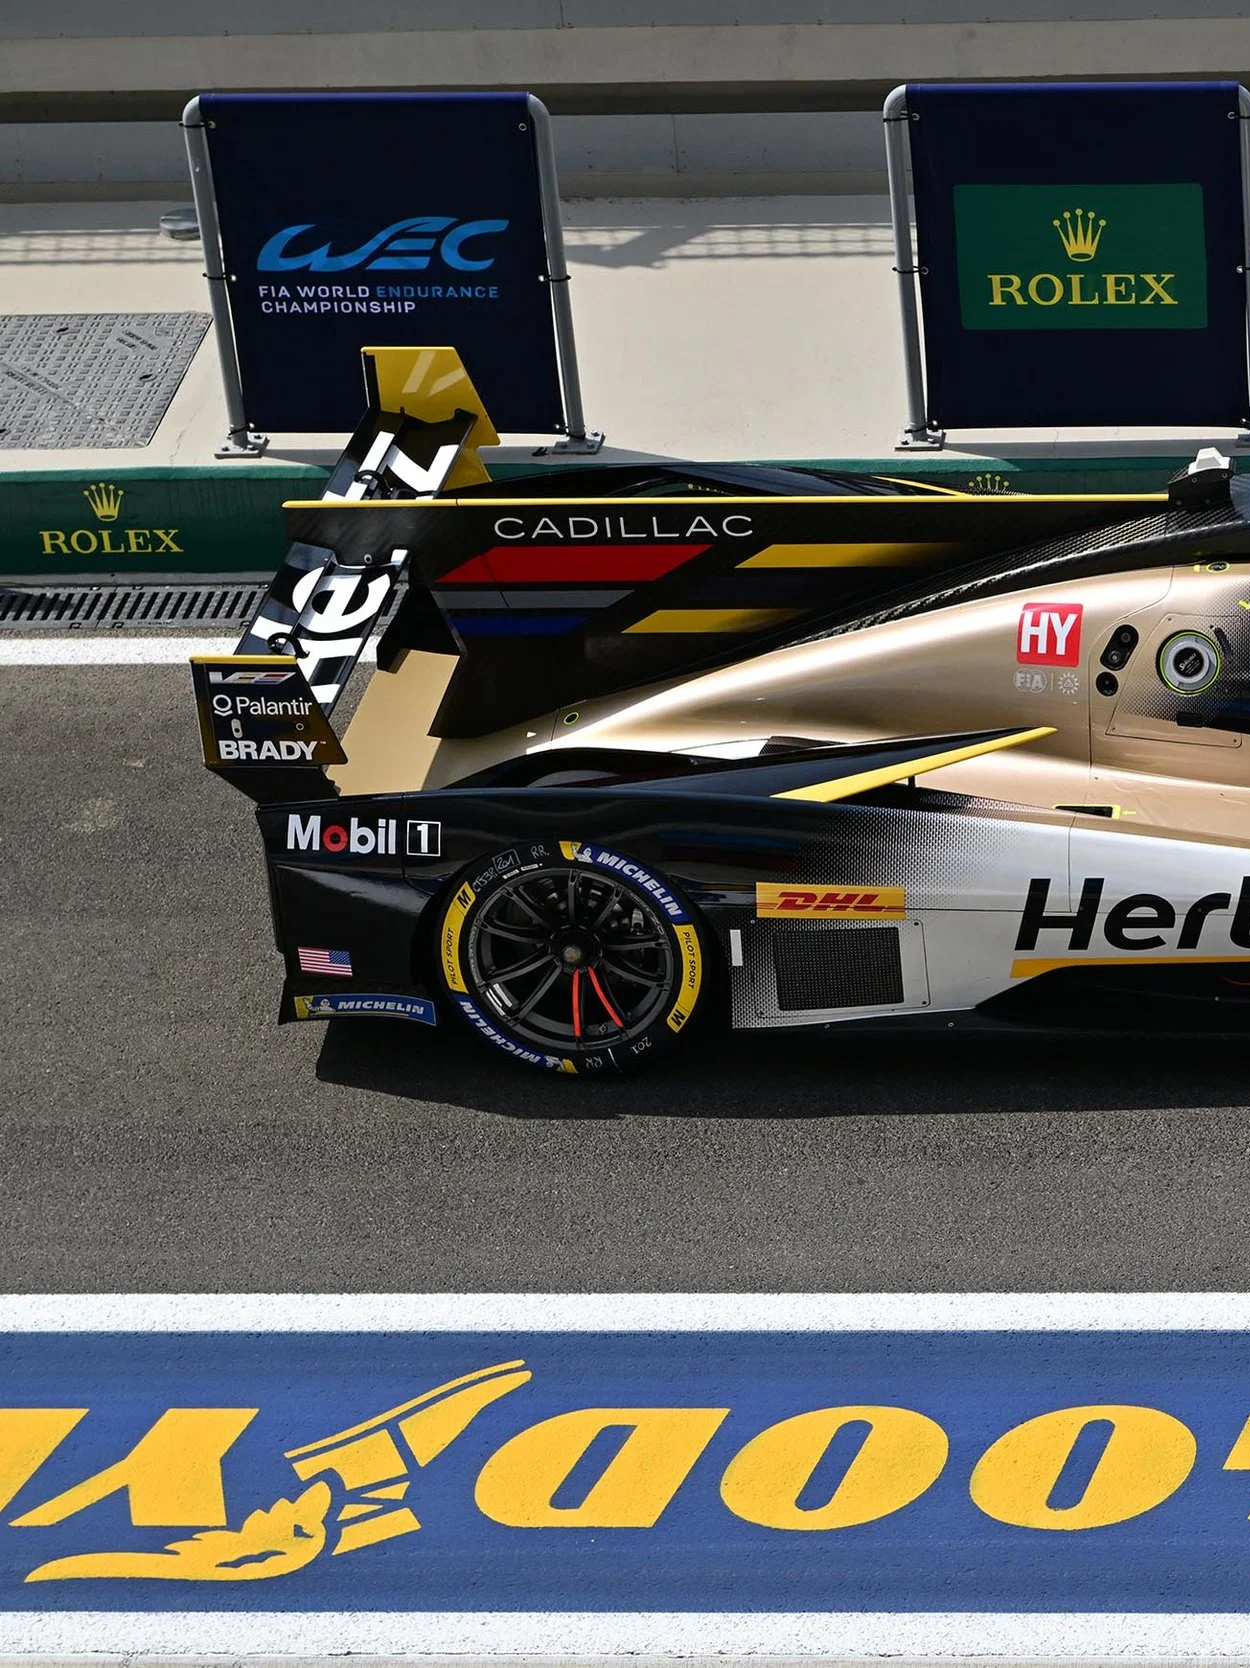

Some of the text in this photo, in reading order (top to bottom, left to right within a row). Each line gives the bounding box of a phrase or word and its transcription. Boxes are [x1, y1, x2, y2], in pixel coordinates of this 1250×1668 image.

[257, 216, 509, 272] WEC
[258, 286, 499, 298] FIA WORLD ENDURANCE
[987, 273, 1178, 306] ROLEX
[261, 301, 416, 313] CHAMPIONSHIP
[494, 515, 753, 539] CADILLAC
[39, 529, 184, 554] ROLEX
[1021, 611, 1078, 656] HY
[236, 696, 313, 715] Palantir
[219, 740, 318, 760] BRADY
[287, 814, 397, 854] Mobil
[597, 851, 683, 916] MICHELIN
[456, 888, 472, 910] M
[777, 891, 886, 913] DHL
[445, 927, 459, 985] PILOT SPORT
[682, 931, 697, 990] PILOT SPORT
[337, 1000, 425, 1015] MICHELIN
[671, 1009, 686, 1027] M
[460, 1001, 541, 1064] MICHELIN
